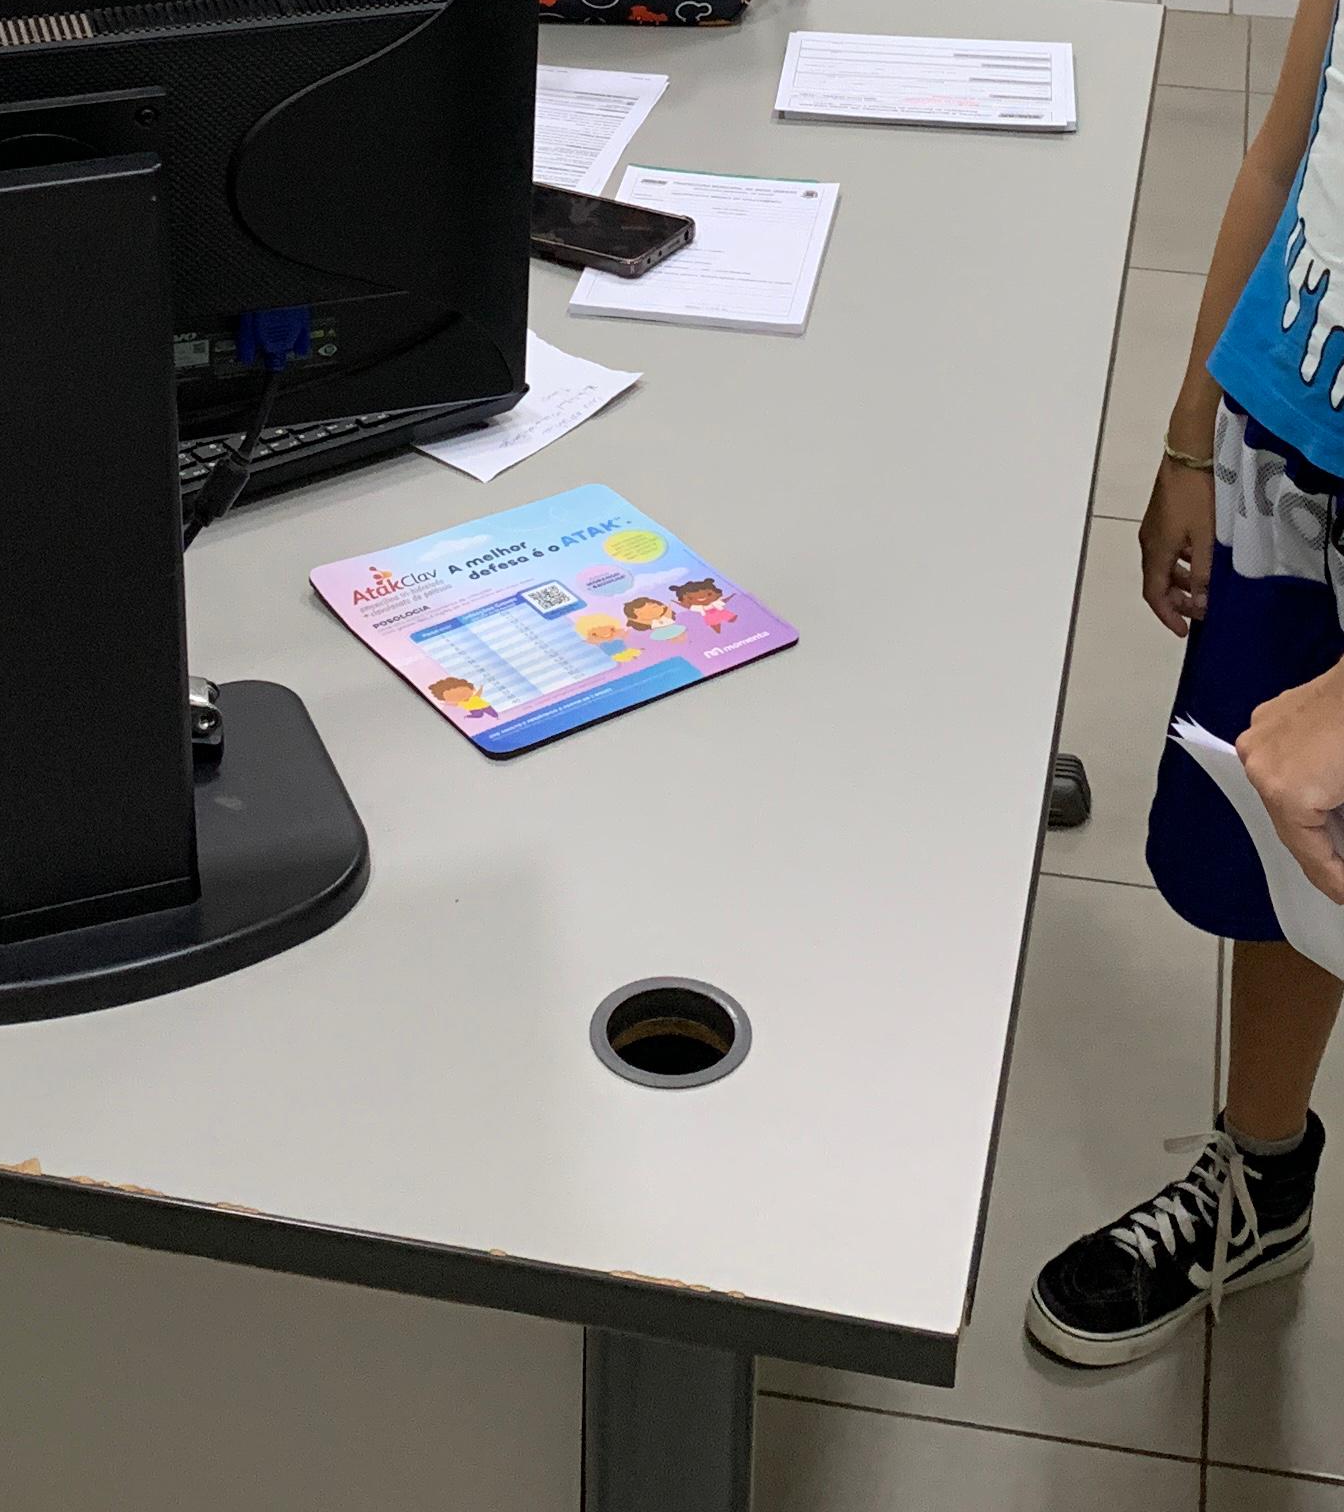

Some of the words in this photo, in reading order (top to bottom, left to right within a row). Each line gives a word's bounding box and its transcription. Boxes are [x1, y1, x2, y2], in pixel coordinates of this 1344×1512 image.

[447, 564, 462, 576] A
[466, 540, 528, 569] melhor
[468, 554, 530, 581] defesa
[531, 546, 545, 558] é
[548, 544, 560, 553] o
[352, 568, 438, 606] AtakClav
[373, 605, 432, 630] POSOLOGIA
